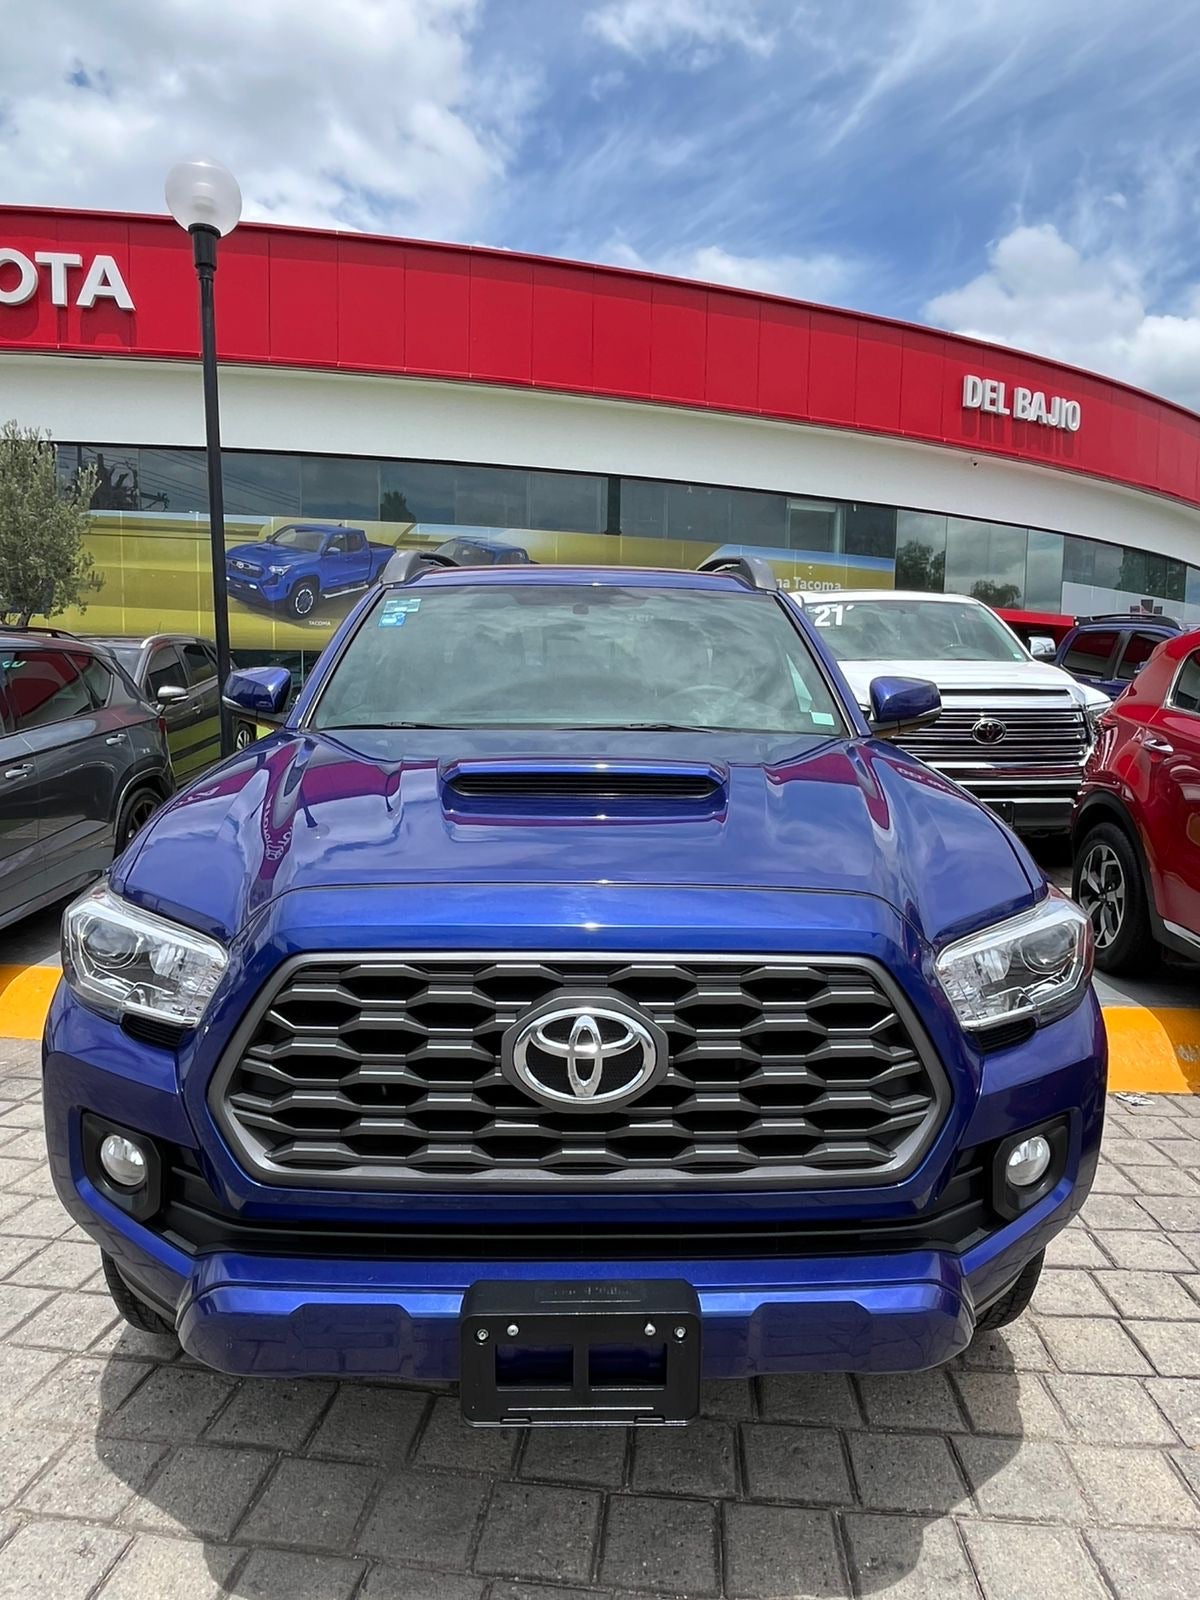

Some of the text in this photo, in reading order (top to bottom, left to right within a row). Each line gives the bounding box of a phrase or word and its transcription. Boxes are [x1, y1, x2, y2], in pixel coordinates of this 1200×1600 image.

[963, 374, 1081, 432] DEL BAJIO
[793, 577, 841, 591] Tacoma
